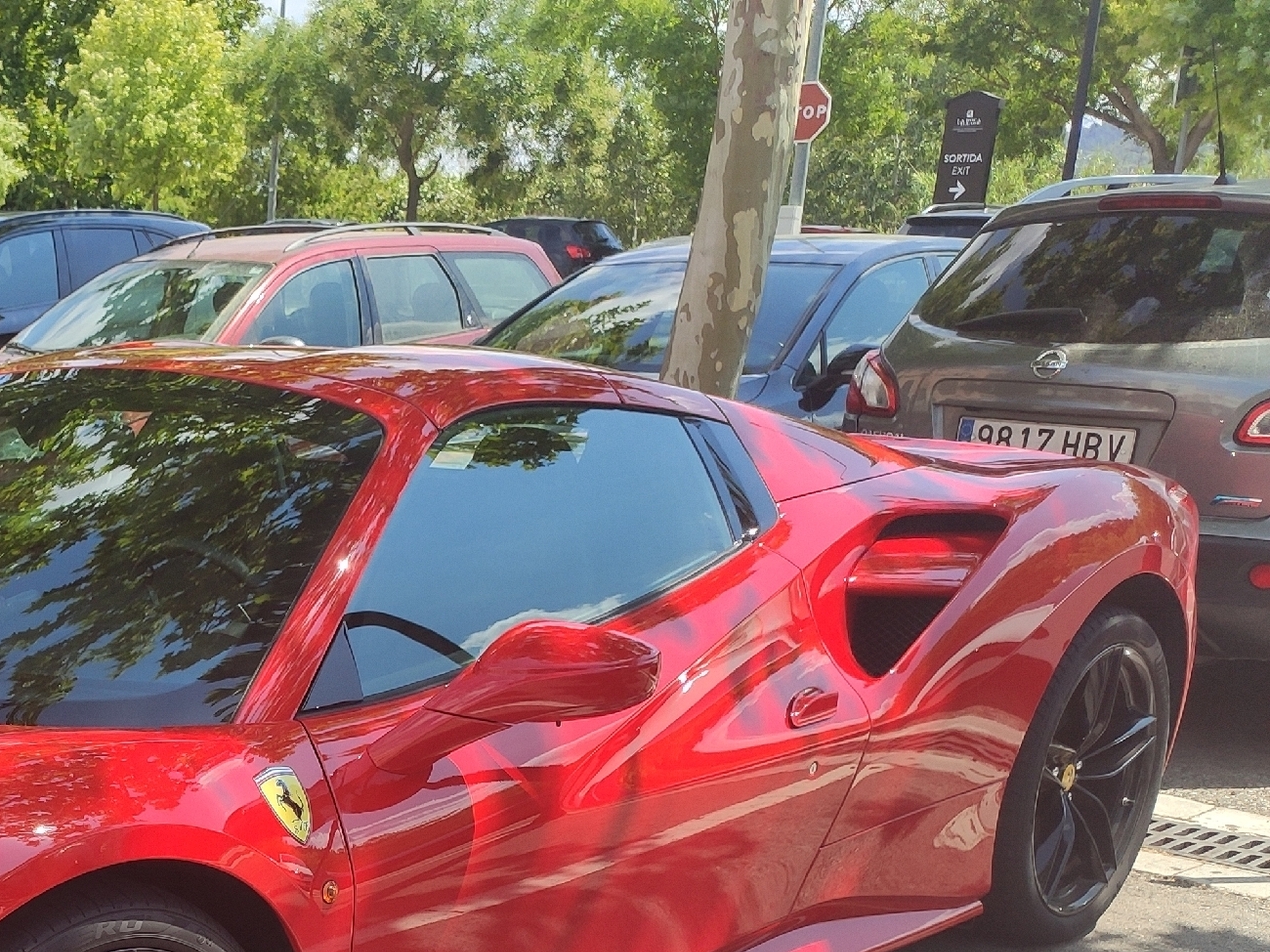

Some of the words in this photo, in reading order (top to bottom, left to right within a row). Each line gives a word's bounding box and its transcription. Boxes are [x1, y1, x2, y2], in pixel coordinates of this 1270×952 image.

[943, 153, 983, 163] SORTIDA
[951, 166, 971, 175] EXIT
[978, 424, 1056, 451] 9817
[1061, 430, 1126, 462] HBV
